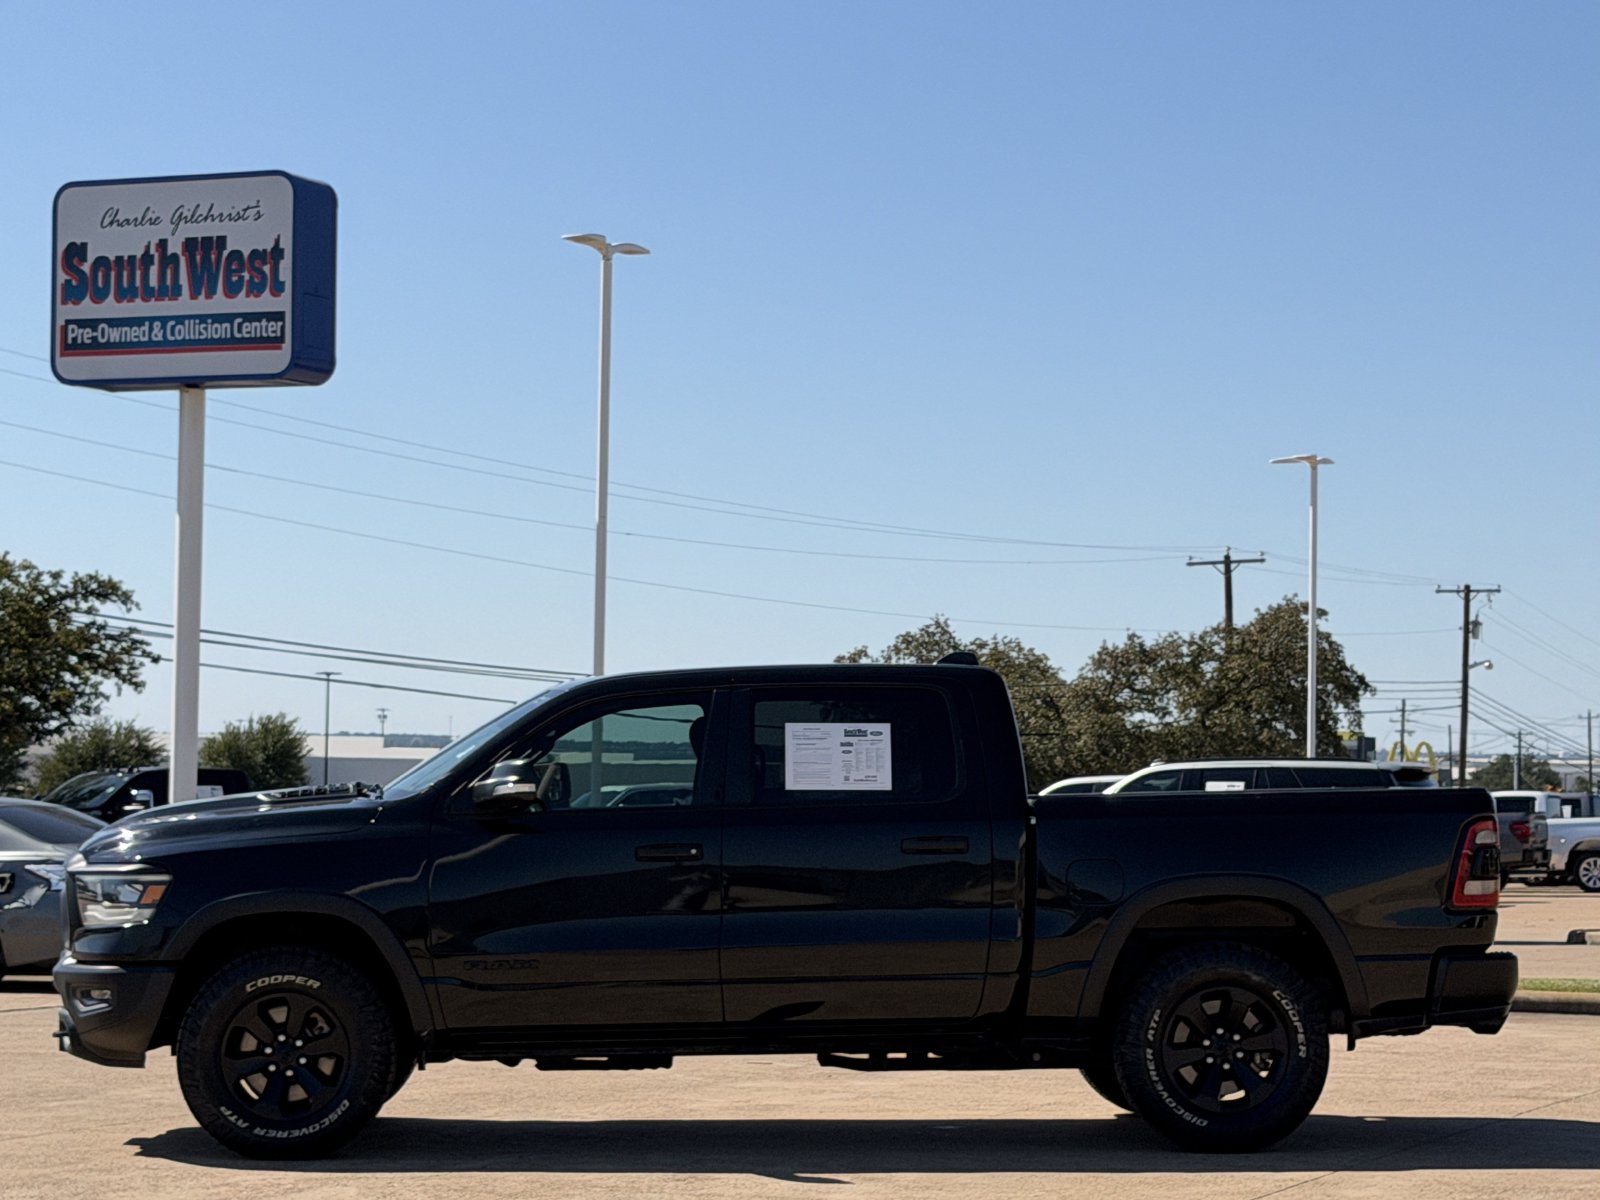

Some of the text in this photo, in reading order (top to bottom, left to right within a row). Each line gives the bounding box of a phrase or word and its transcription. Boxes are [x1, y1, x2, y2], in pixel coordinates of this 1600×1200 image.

[100, 200, 267, 235] Charlie Gilchrist's
[60, 234, 287, 306] SouthWest
[66, 316, 284, 345] Pre-Owned & Collision Center
[245, 974, 321, 993] COOPER
[1272, 989, 1307, 1058] COOPER
[1145, 1048, 1209, 1127] DISCOVERER
[252, 1099, 350, 1138] DISCOVERER
